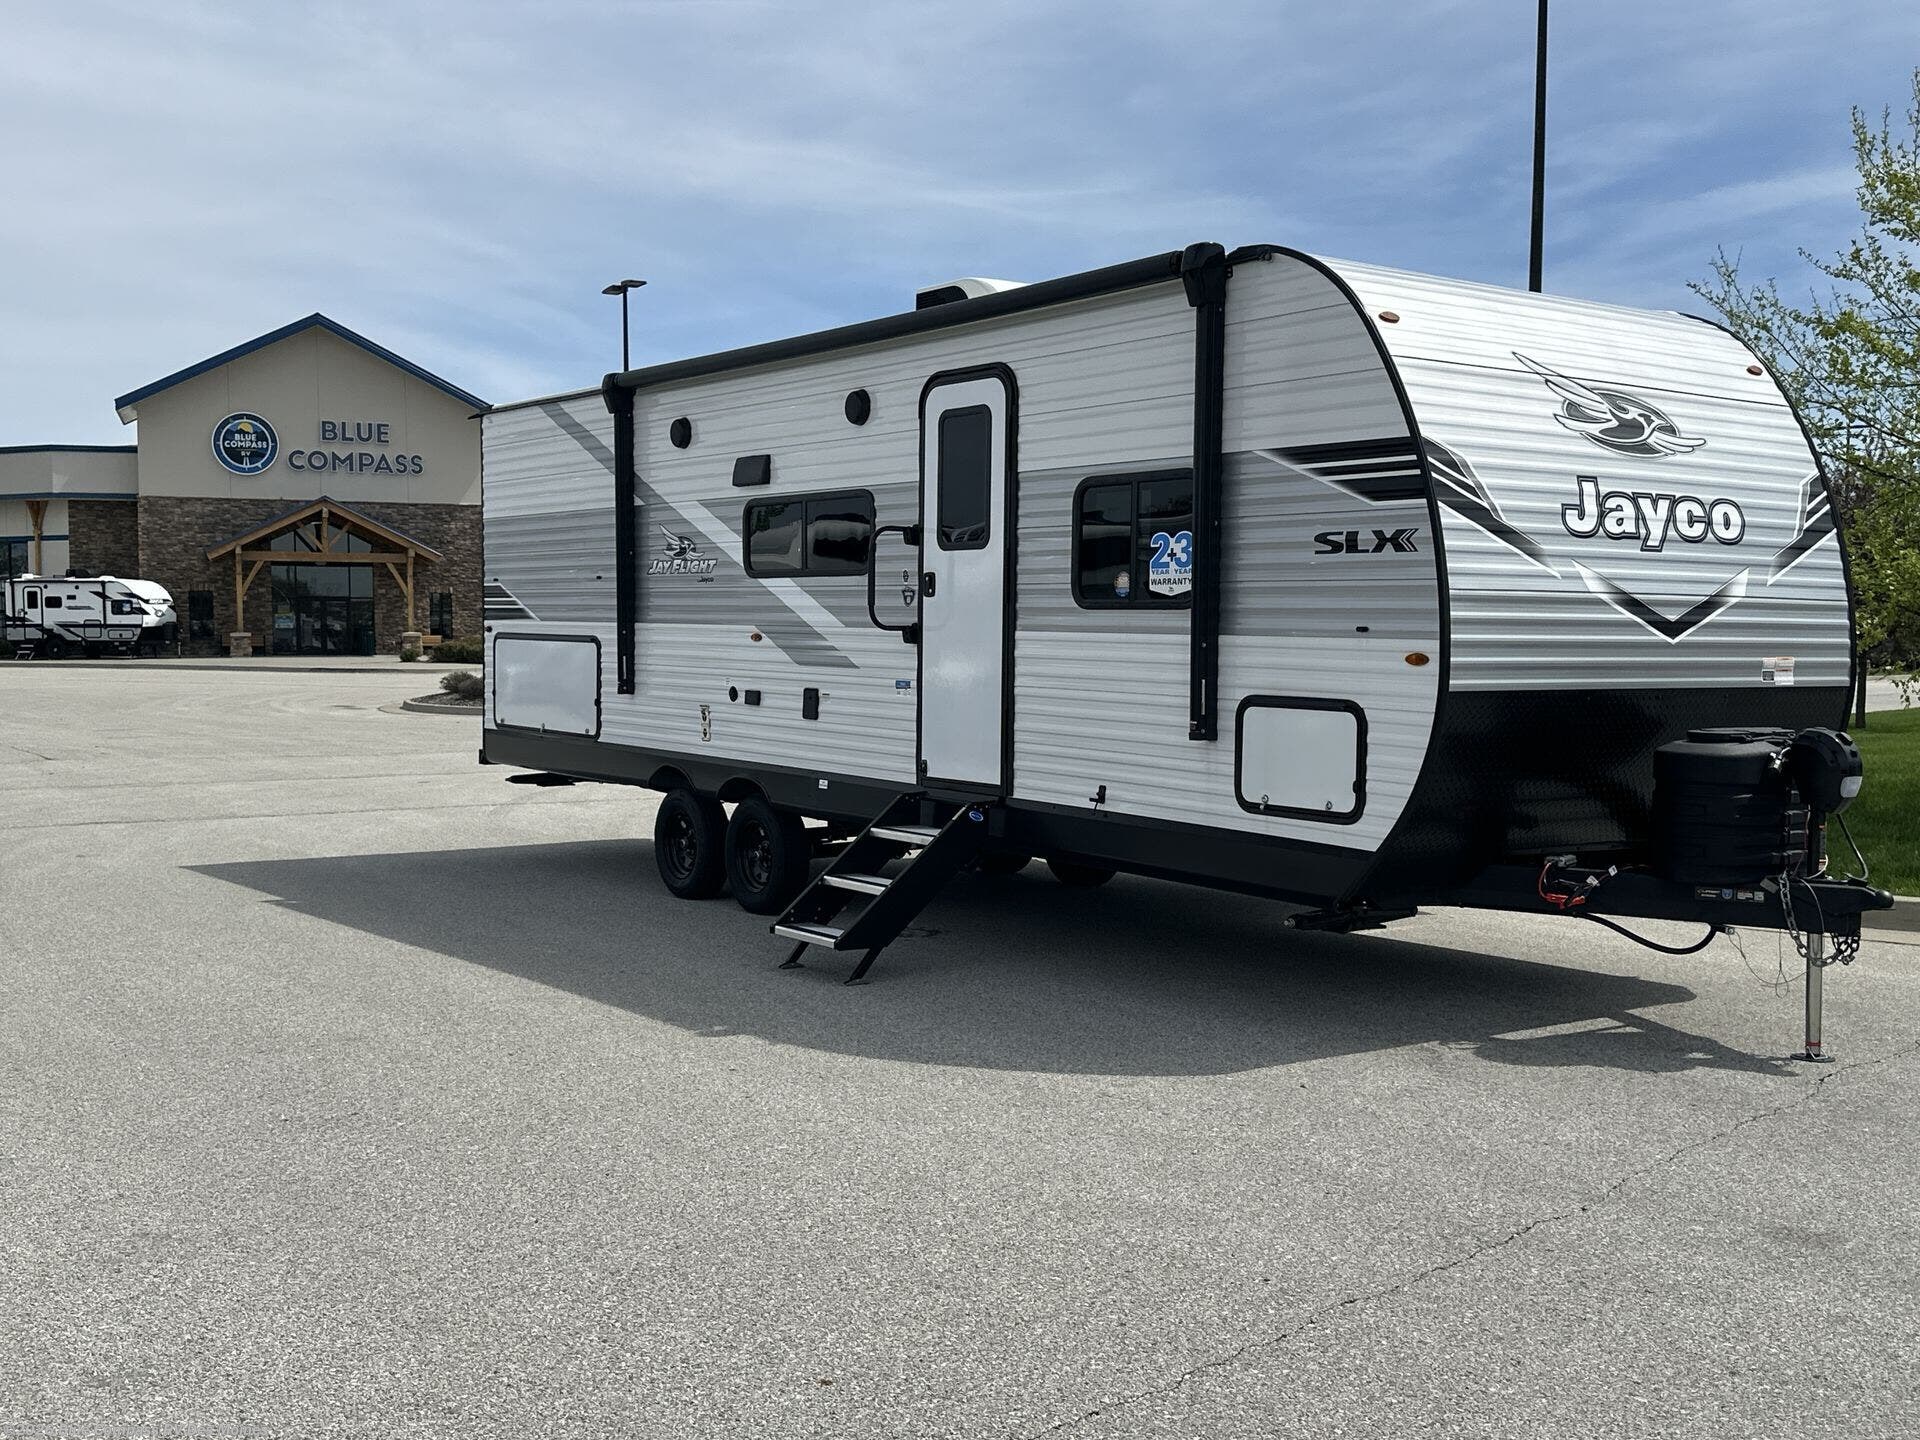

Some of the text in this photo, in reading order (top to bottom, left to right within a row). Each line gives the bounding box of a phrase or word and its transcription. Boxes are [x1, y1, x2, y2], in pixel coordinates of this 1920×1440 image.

[234, 433, 257, 441] BLUE
[321, 420, 390, 444] BLUE
[224, 440, 268, 449] COMPASS
[288, 449, 425, 475] COMPASS
[1561, 475, 1746, 552] Jayco
[1313, 528, 1420, 555] SLX
[647, 559, 718, 575] JAY FLIGHT
[1151, 578, 1192, 586] WARRANTY
